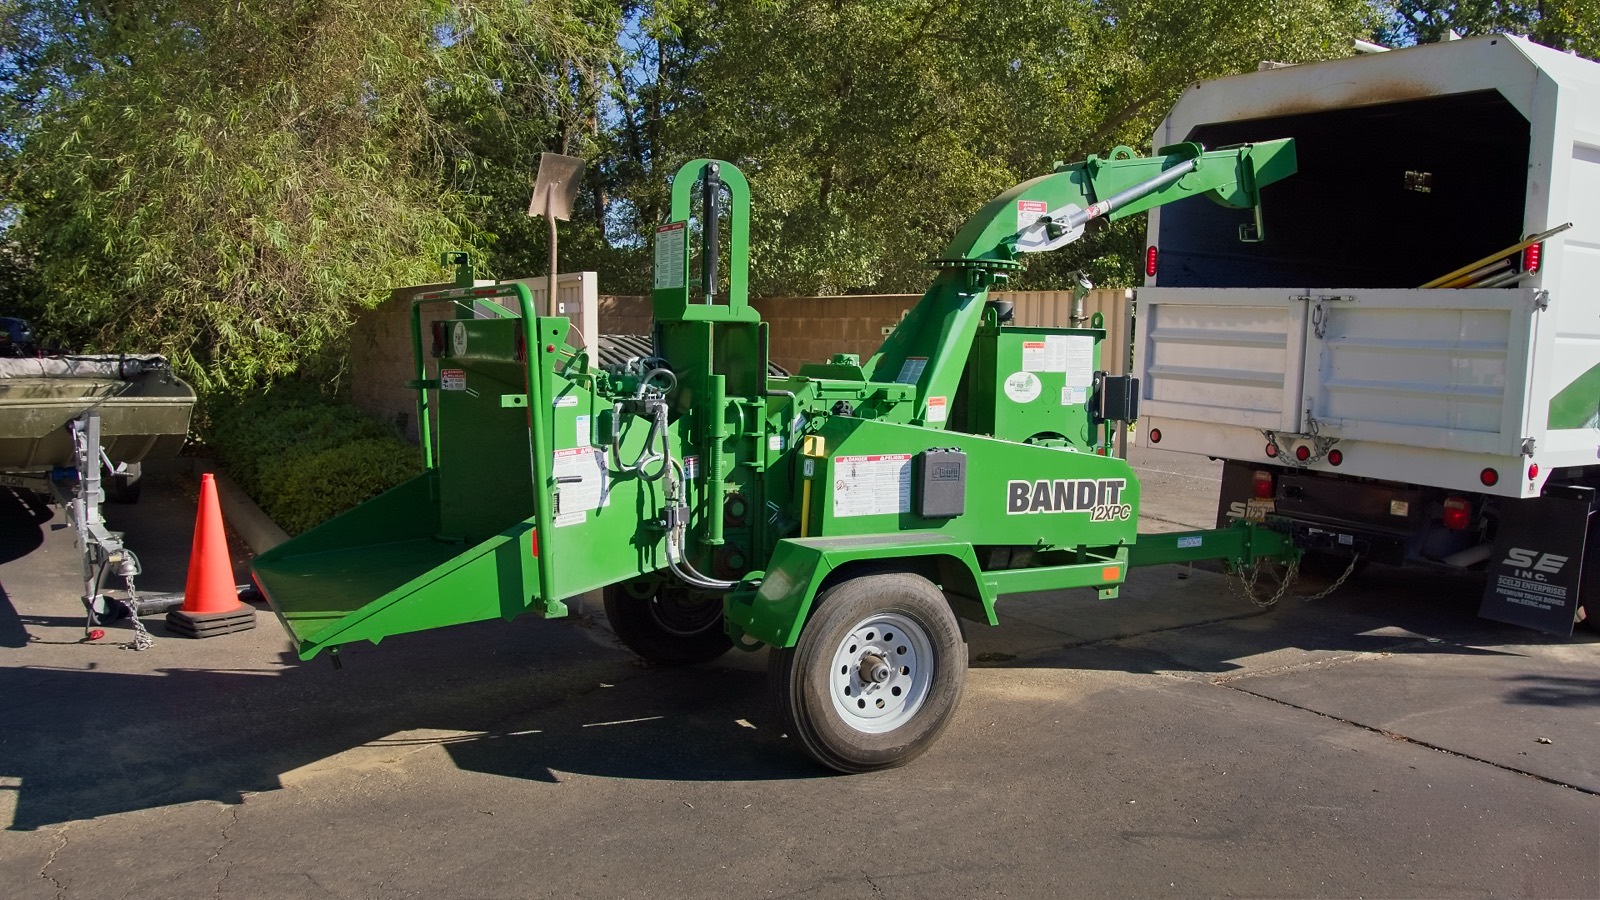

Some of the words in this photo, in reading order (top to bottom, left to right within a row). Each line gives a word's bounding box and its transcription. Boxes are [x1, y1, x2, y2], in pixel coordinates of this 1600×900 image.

[1007, 479, 1125, 513] BANDIT
[1090, 505, 1131, 521] 12XPC
[1502, 547, 1569, 574] SE
[1514, 569, 1548, 582] INC.
[1496, 587, 1524, 598] PREMIUM
[1524, 592, 1543, 602] TRUCK
[1543, 597, 1565, 607] BODIES
[1498, 577, 1522, 588] SCELZI
[1522, 582, 1567, 597] ENTERPRISES
